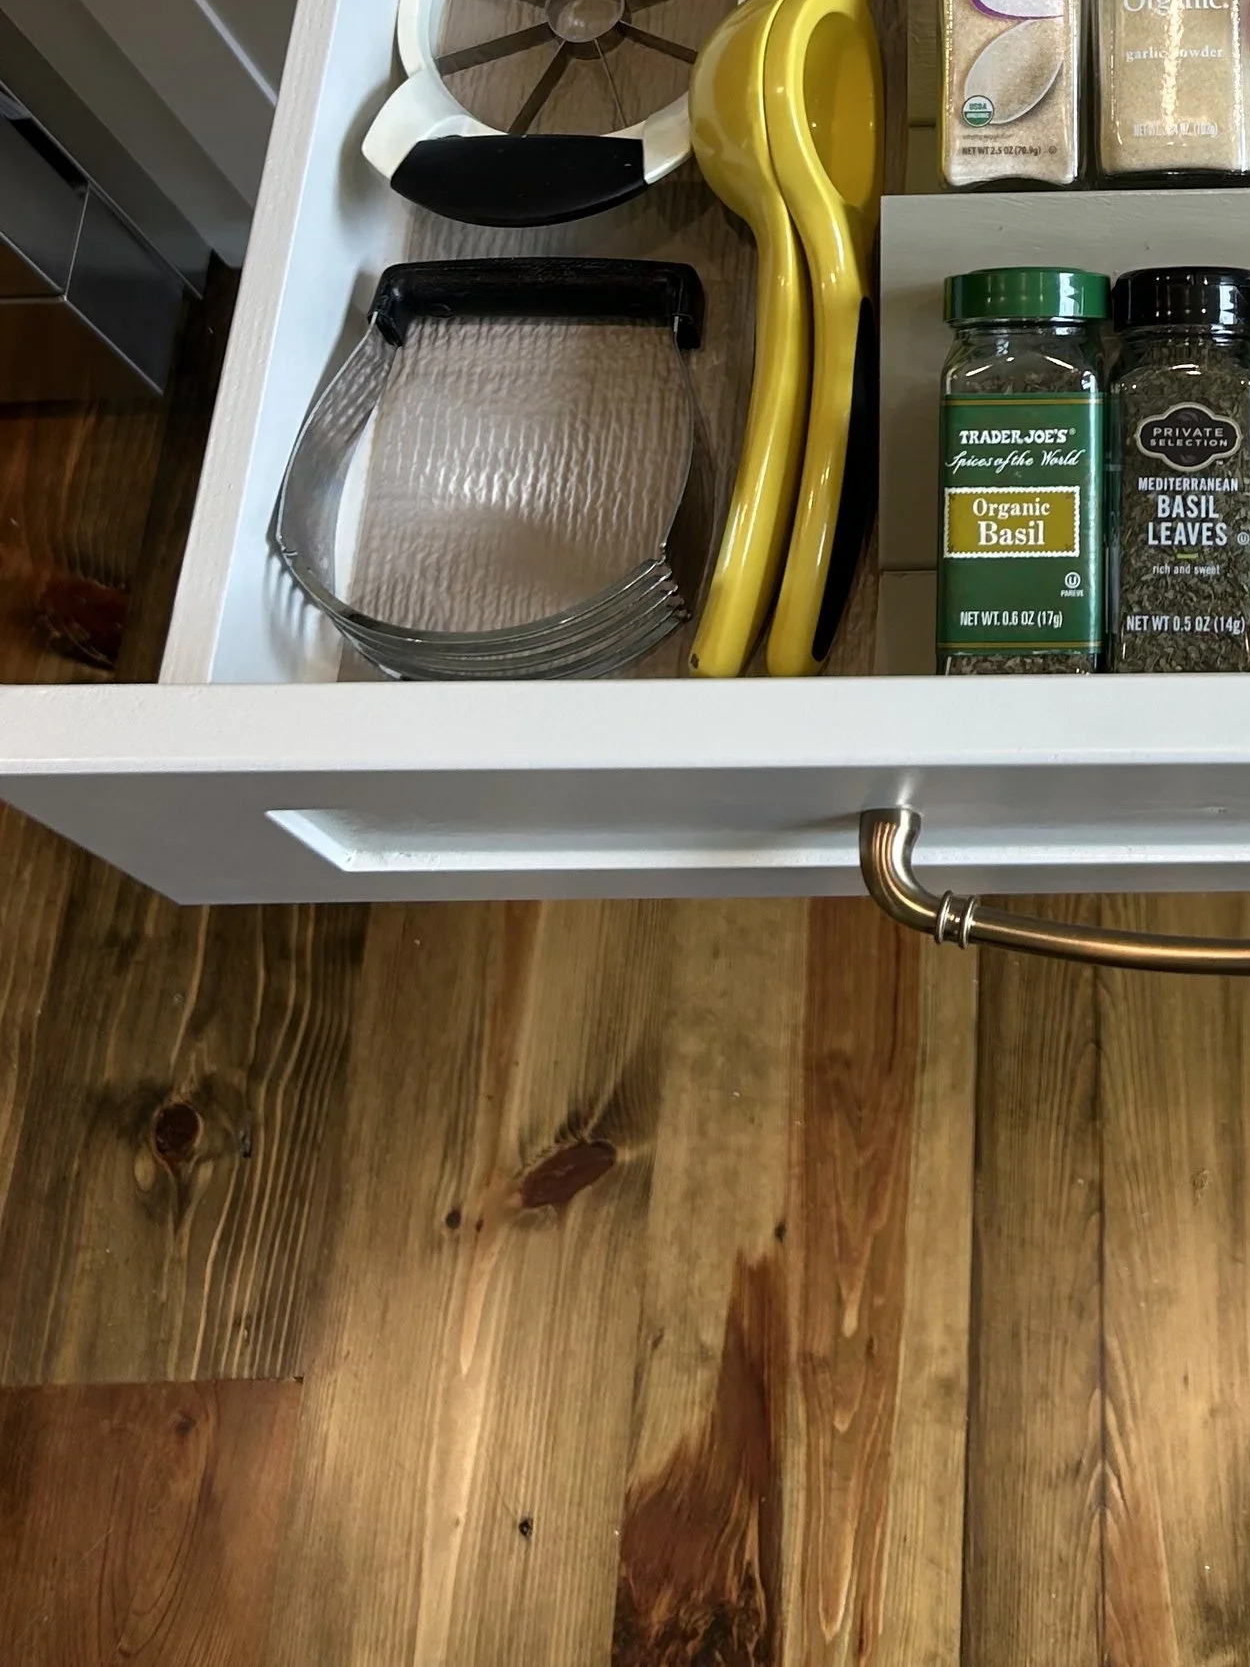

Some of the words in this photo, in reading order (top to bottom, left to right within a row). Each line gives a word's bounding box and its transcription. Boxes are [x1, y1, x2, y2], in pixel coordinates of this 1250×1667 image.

[960, 429, 1024, 444] TRADER
[1024, 428, 1069, 444] JOE'S
[1153, 427, 1224, 437] PRIVATE
[1150, 438, 1228, 447] SELECTION
[945, 450, 992, 474] Spices
[991, 451, 1012, 474] of
[1009, 449, 1035, 468] the
[1040, 448, 1086, 466] World
[1138, 477, 1239, 492] MEDITERRANEAN
[972, 497, 1051, 520] Organic
[1157, 494, 1219, 518] BASIL
[977, 520, 1046, 546] Basil
[1147, 522, 1228, 547] LEAVES
[1152, 563, 1171, 574] rich
[1173, 564, 1191, 575] and
[1194, 564, 1220, 575] sweet
[960, 611, 981, 627] NET
[982, 611, 1001, 626] WT.
[1002, 611, 1020, 626] 0.6
[1020, 611, 1035, 626] OZ
[1037, 611, 1063, 629] (17g)
[1126, 616, 1150, 632] NET
[1152, 616, 1171, 631] WT
[1173, 615, 1192, 632] 0.5
[1195, 616, 1211, 632] OZ
[1214, 615, 1246, 635] (14g)
